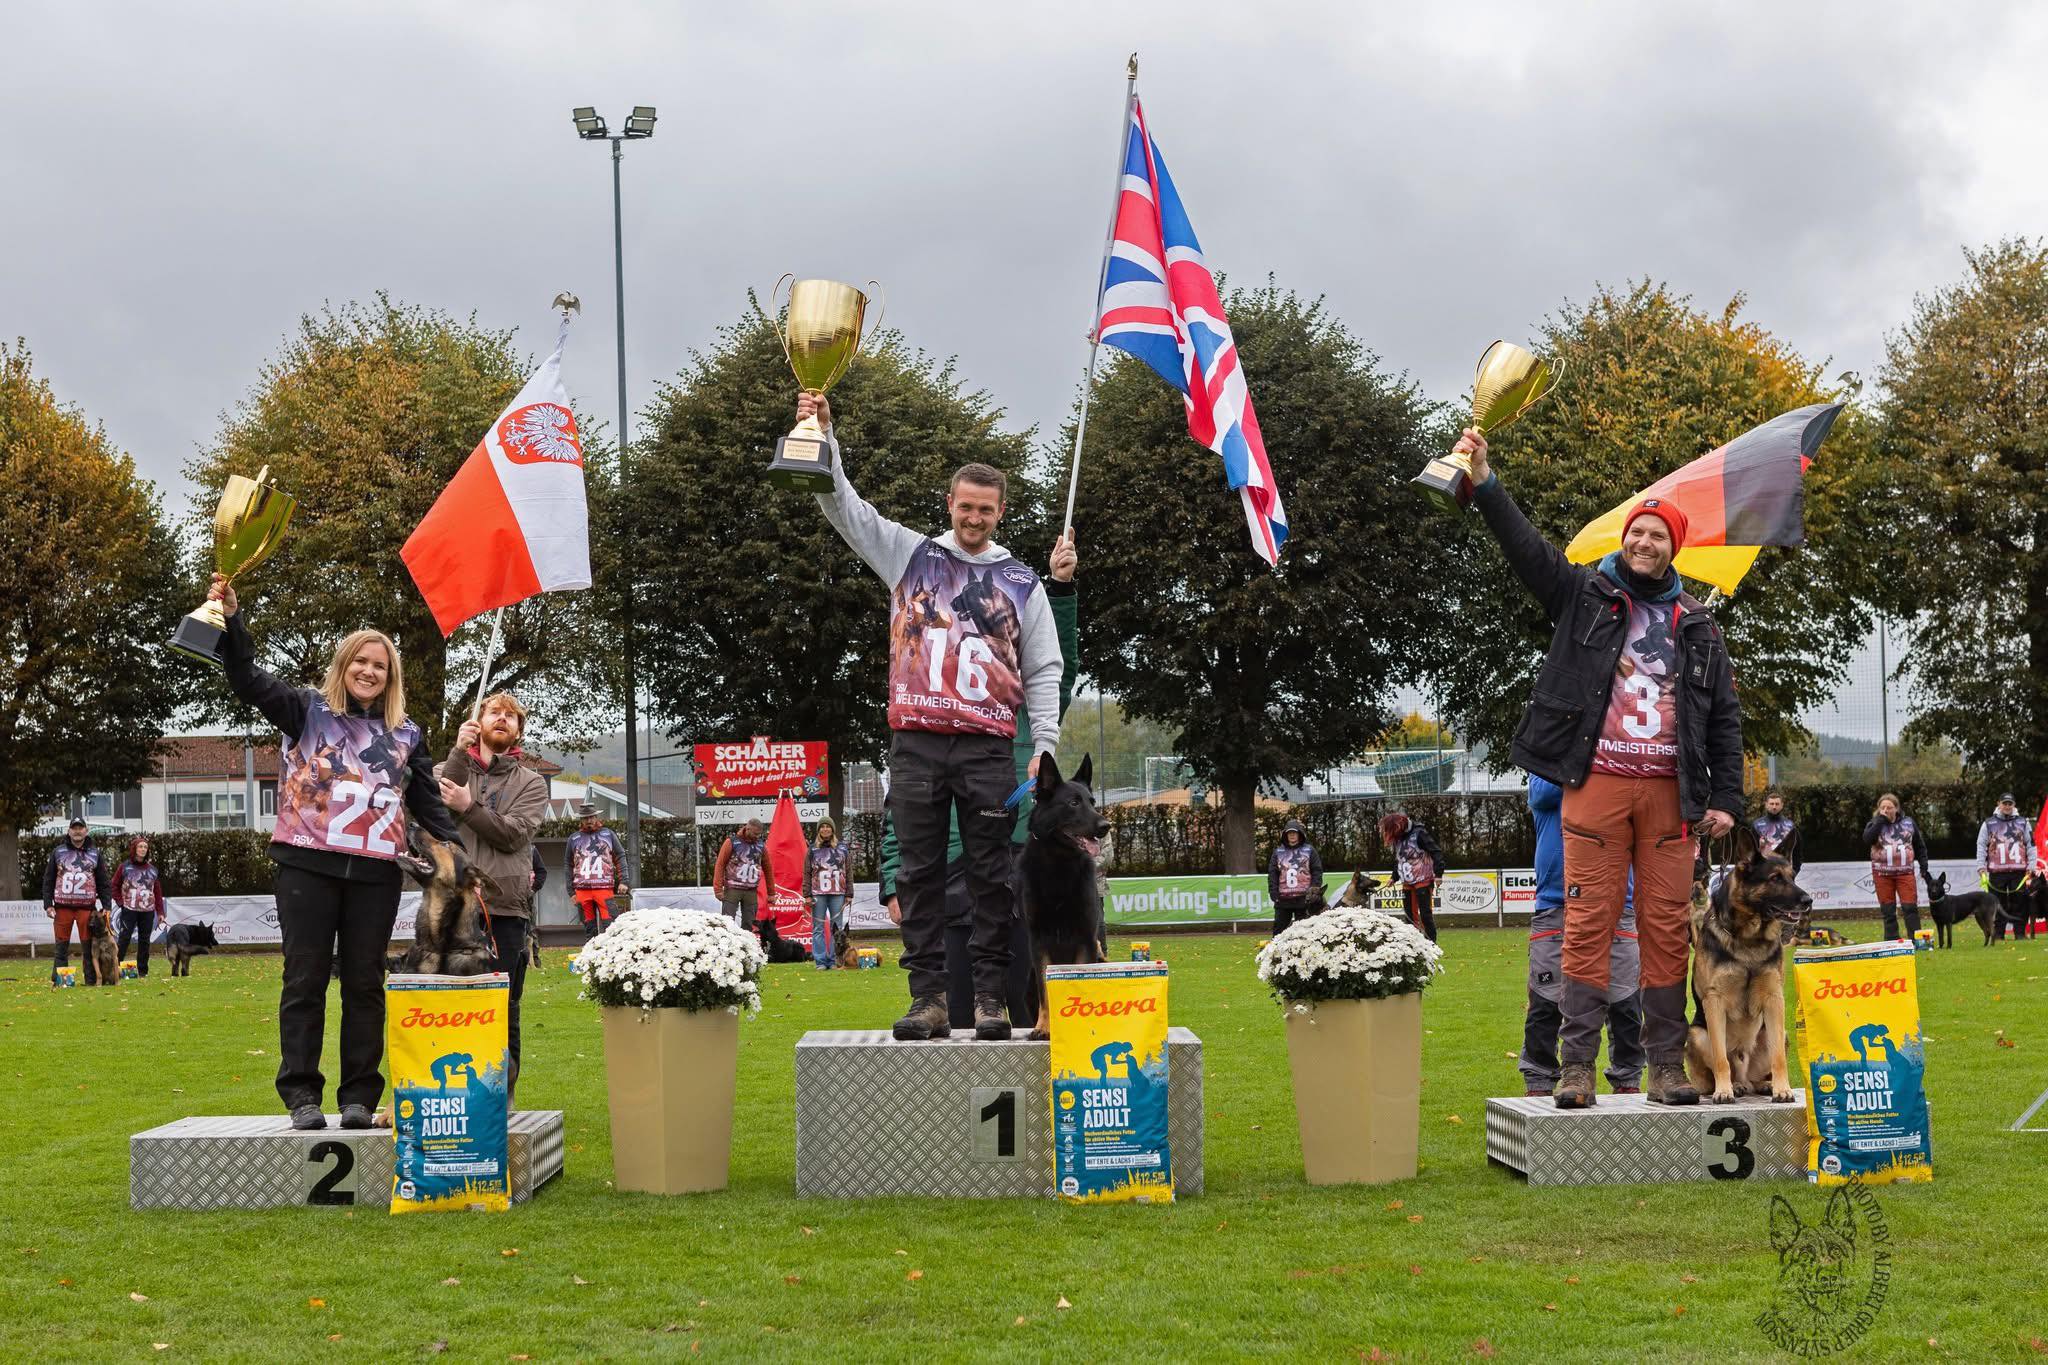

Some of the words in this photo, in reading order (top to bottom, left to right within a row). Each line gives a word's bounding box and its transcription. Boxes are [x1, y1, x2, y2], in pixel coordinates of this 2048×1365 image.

[927, 627, 994, 702] 16
[1622, 675, 1661, 740] 3
[714, 736, 806, 760] SCHÄFER
[715, 760, 807, 773] AUTOMATEN
[723, 777, 752, 789] Spielend
[753, 774, 765, 786] gut
[765, 771, 785, 782] drauf
[326, 780, 400, 855] 22
[698, 810, 719, 820] TSV/
[722, 810, 735, 819] FC
[800, 808, 826, 817] GAST
[292, 834, 314, 846] RSV
[1883, 844, 1907, 867] 11
[1997, 842, 2022, 865] 14
[580, 855, 604, 880] 44
[736, 864, 760, 884] 40
[1286, 868, 1298, 888] 6
[61, 872, 88, 895] 62
[818, 870, 841, 892] 61
[1814, 977, 1907, 1000] Josera
[400, 1007, 496, 1028] Josera
[1060, 996, 1157, 1018] Josera
[1843, 1070, 1889, 1092] SENSI
[421, 1096, 466, 1117] SENSI
[1082, 1087, 1128, 1108] SENSI
[1846, 1091, 1894, 1112] ADULT
[422, 1116, 469, 1137] ADULT
[981, 1091, 1015, 1157] 1
[1083, 1108, 1131, 1129] ADULT
[1707, 1117, 1755, 1181] 3
[307, 1141, 354, 1205] 2
